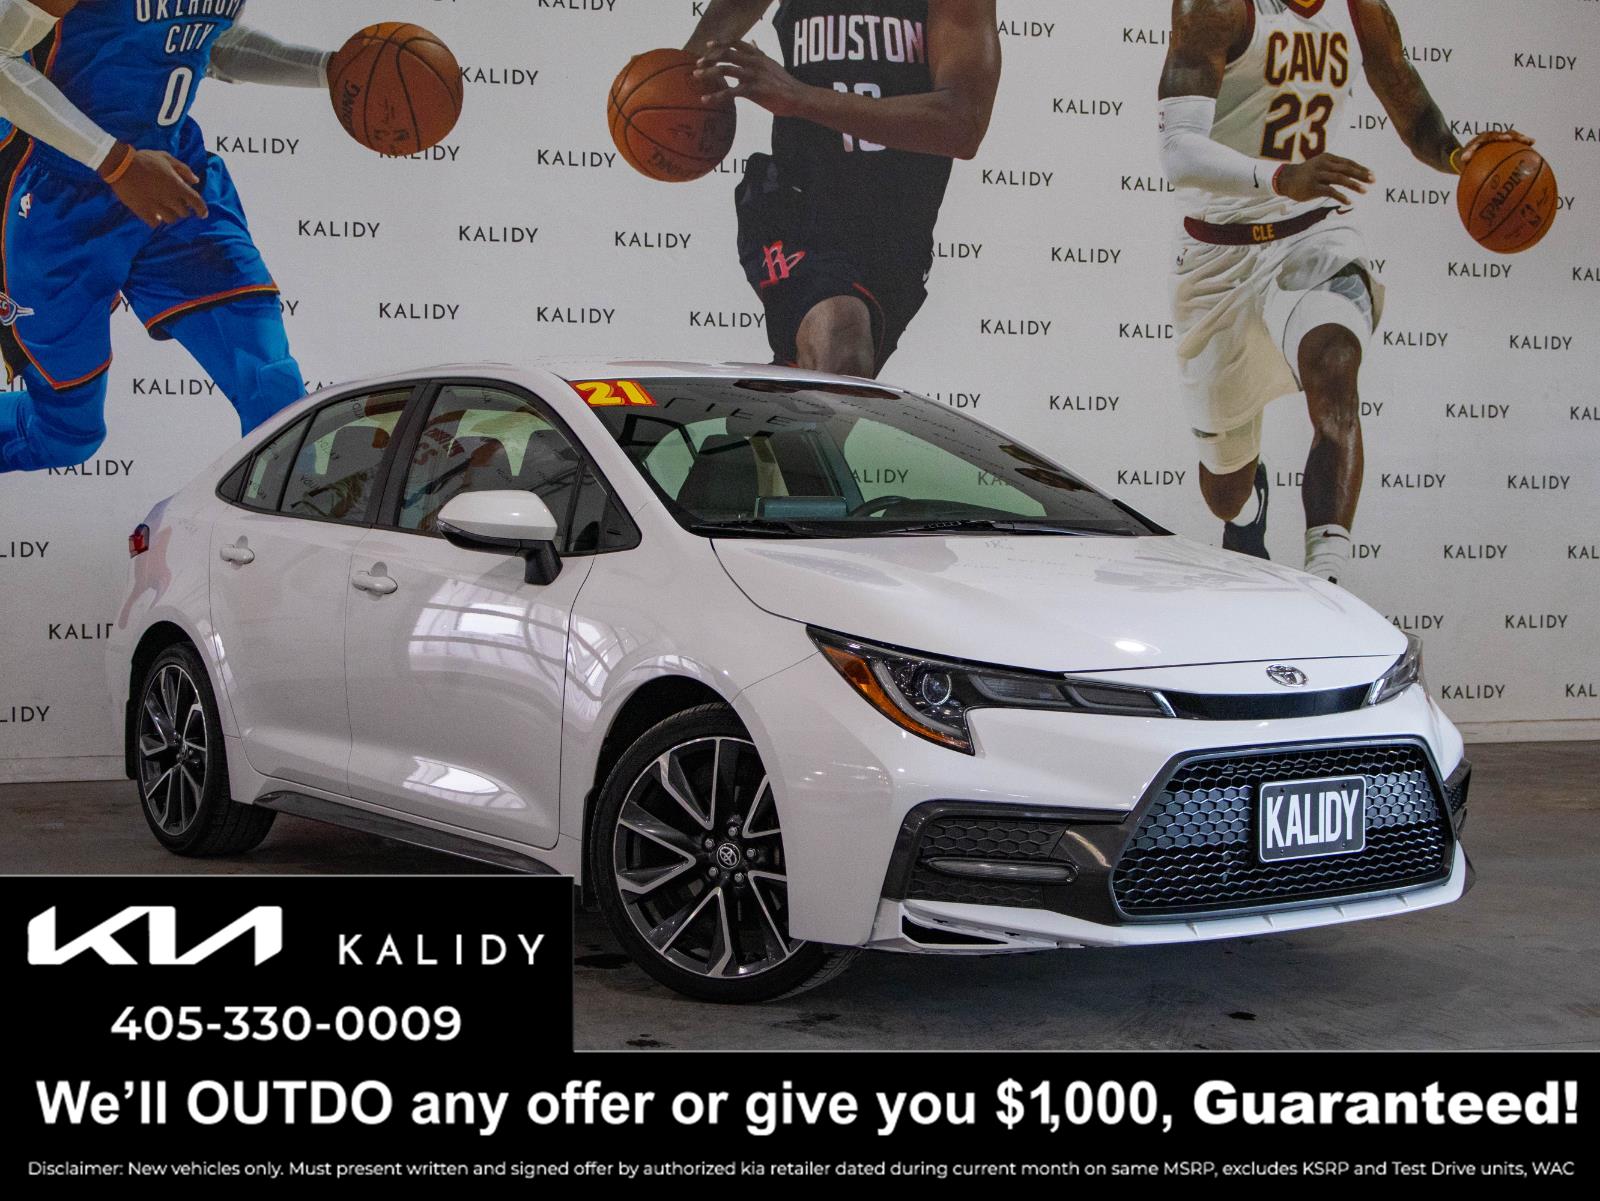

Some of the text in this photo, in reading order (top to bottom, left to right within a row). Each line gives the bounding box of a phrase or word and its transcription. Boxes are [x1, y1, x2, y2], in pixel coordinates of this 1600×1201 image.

[165, 23, 214, 53] CITY
[793, 14, 925, 67] HOUSTON
[1123, 28, 1172, 45] KALI
[1264, 30, 1349, 88] CAVS
[1514, 53, 1577, 70] KALIDY
[462, 67, 539, 85] KALIDY
[157, 66, 193, 126] 0
[1053, 98, 1123, 116] KALIDY
[1259, 92, 1334, 161] 23
[1350, 115, 1388, 130] IDY
[217, 136, 300, 154] KALIDY
[537, 149, 617, 168] KALIDY
[982, 170, 1054, 187] KALIDY
[1386, 188, 1450, 205] KALIDY
[298, 220, 380, 238] KALIDY
[459, 226, 539, 243] KALIDY
[1252, 223, 1275, 242] CLE
[614, 231, 692, 249] KALIDY
[1051, 247, 1121, 264] KALIDY
[1448, 262, 1512, 278] KALIDY
[379, 303, 460, 320] KALIDY
[537, 307, 616, 325] KALIDY
[690, 311, 765, 328] KALIDY
[981, 319, 1052, 336] KALIDY
[1383, 331, 1448, 347] KALIDY
[1509, 335, 1573, 351] KALIDY
[133, 378, 216, 396] KALIDY
[576, 380, 652, 405] 21
[1049, 396, 1120, 411] KALIDY
[1446, 404, 1510, 419] KALIDY
[1117, 470, 1186, 486] KALIDY
[1381, 473, 1446, 489] KALIDY
[1508, 475, 1571, 490] KALIDY
[1444, 545, 1508, 560] KALIDY
[1385, 615, 1444, 630] ALIDY
[1505, 614, 1568, 629] KALIDY
[1442, 684, 1506, 700] KALIDY
[1266, 789, 1360, 848] KALIDY
